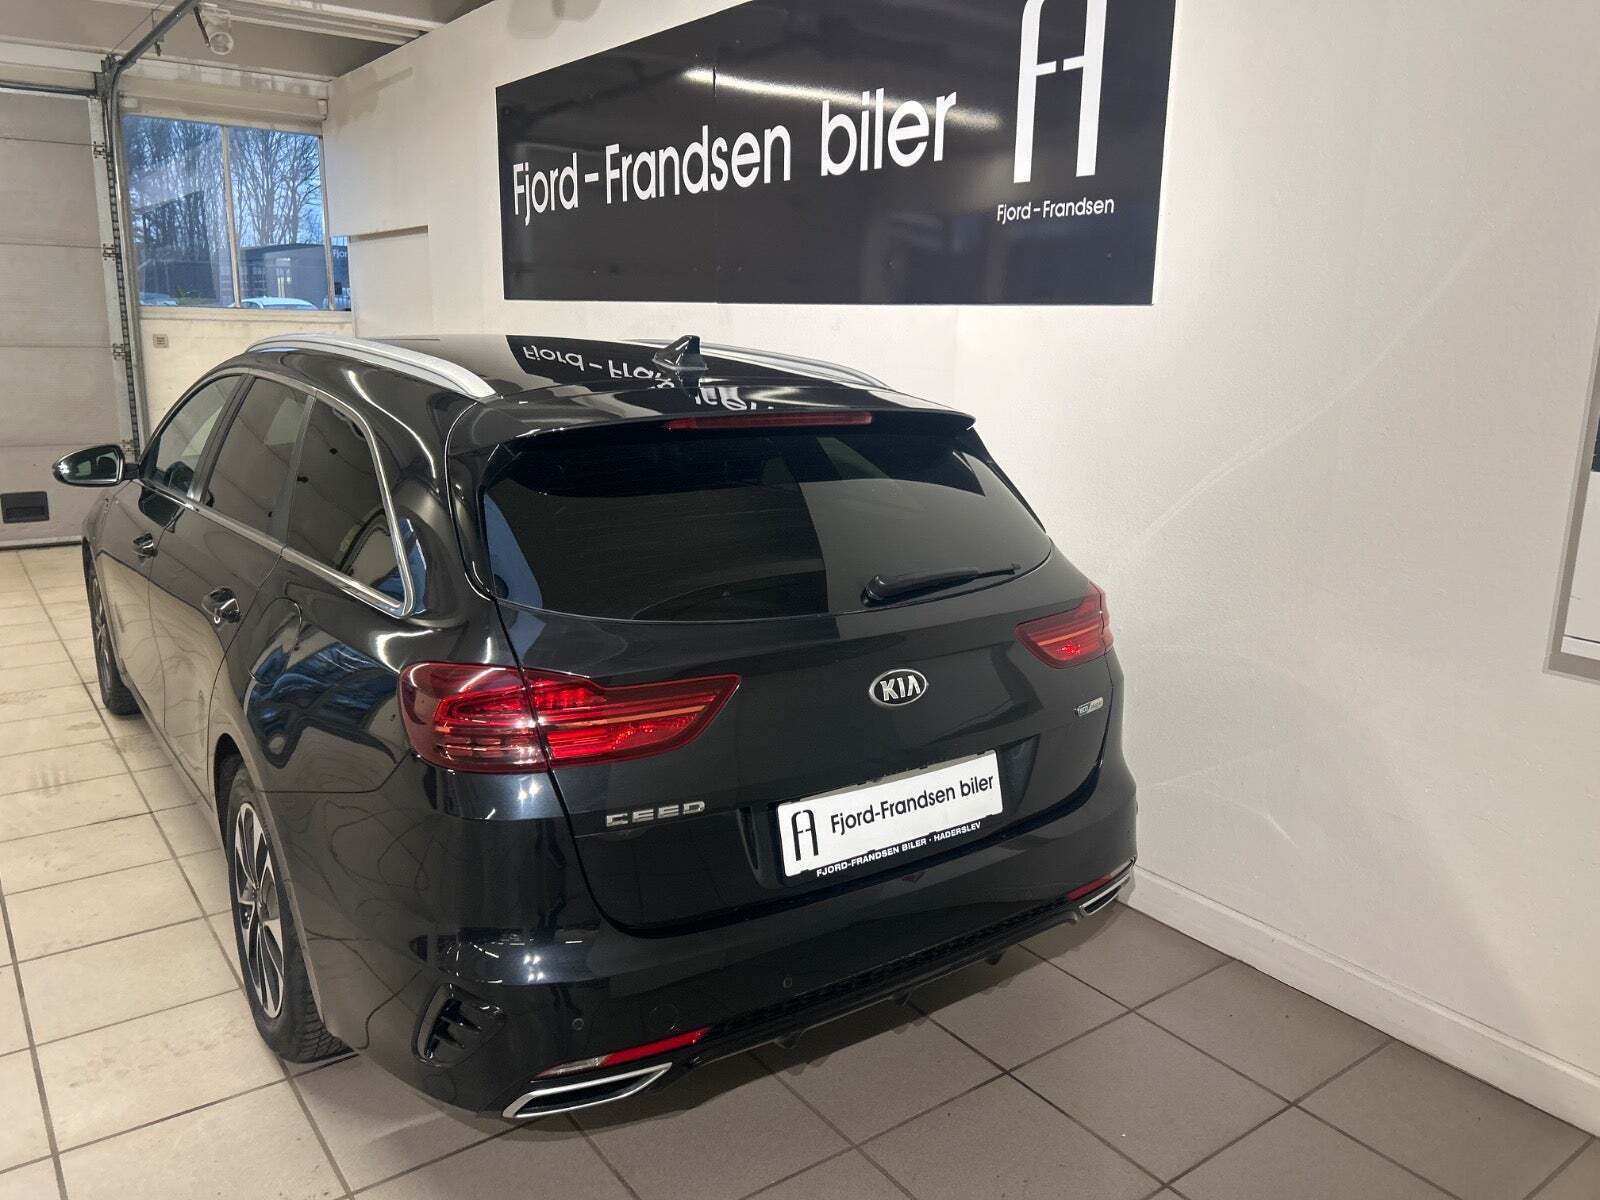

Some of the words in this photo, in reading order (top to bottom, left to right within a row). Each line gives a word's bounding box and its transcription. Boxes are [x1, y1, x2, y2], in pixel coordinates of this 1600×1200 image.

[821, 87, 957, 177] biler
[880, 674, 921, 701] KIA
[606, 801, 706, 828] CEED
[831, 786, 955, 836] Fjord-Frandsen
[960, 775, 994, 798] biler
[816, 846, 900, 878] FJORD-FRANDSEN
[902, 838, 927, 851] BILER
[934, 821, 982, 843] HADERSLEV
